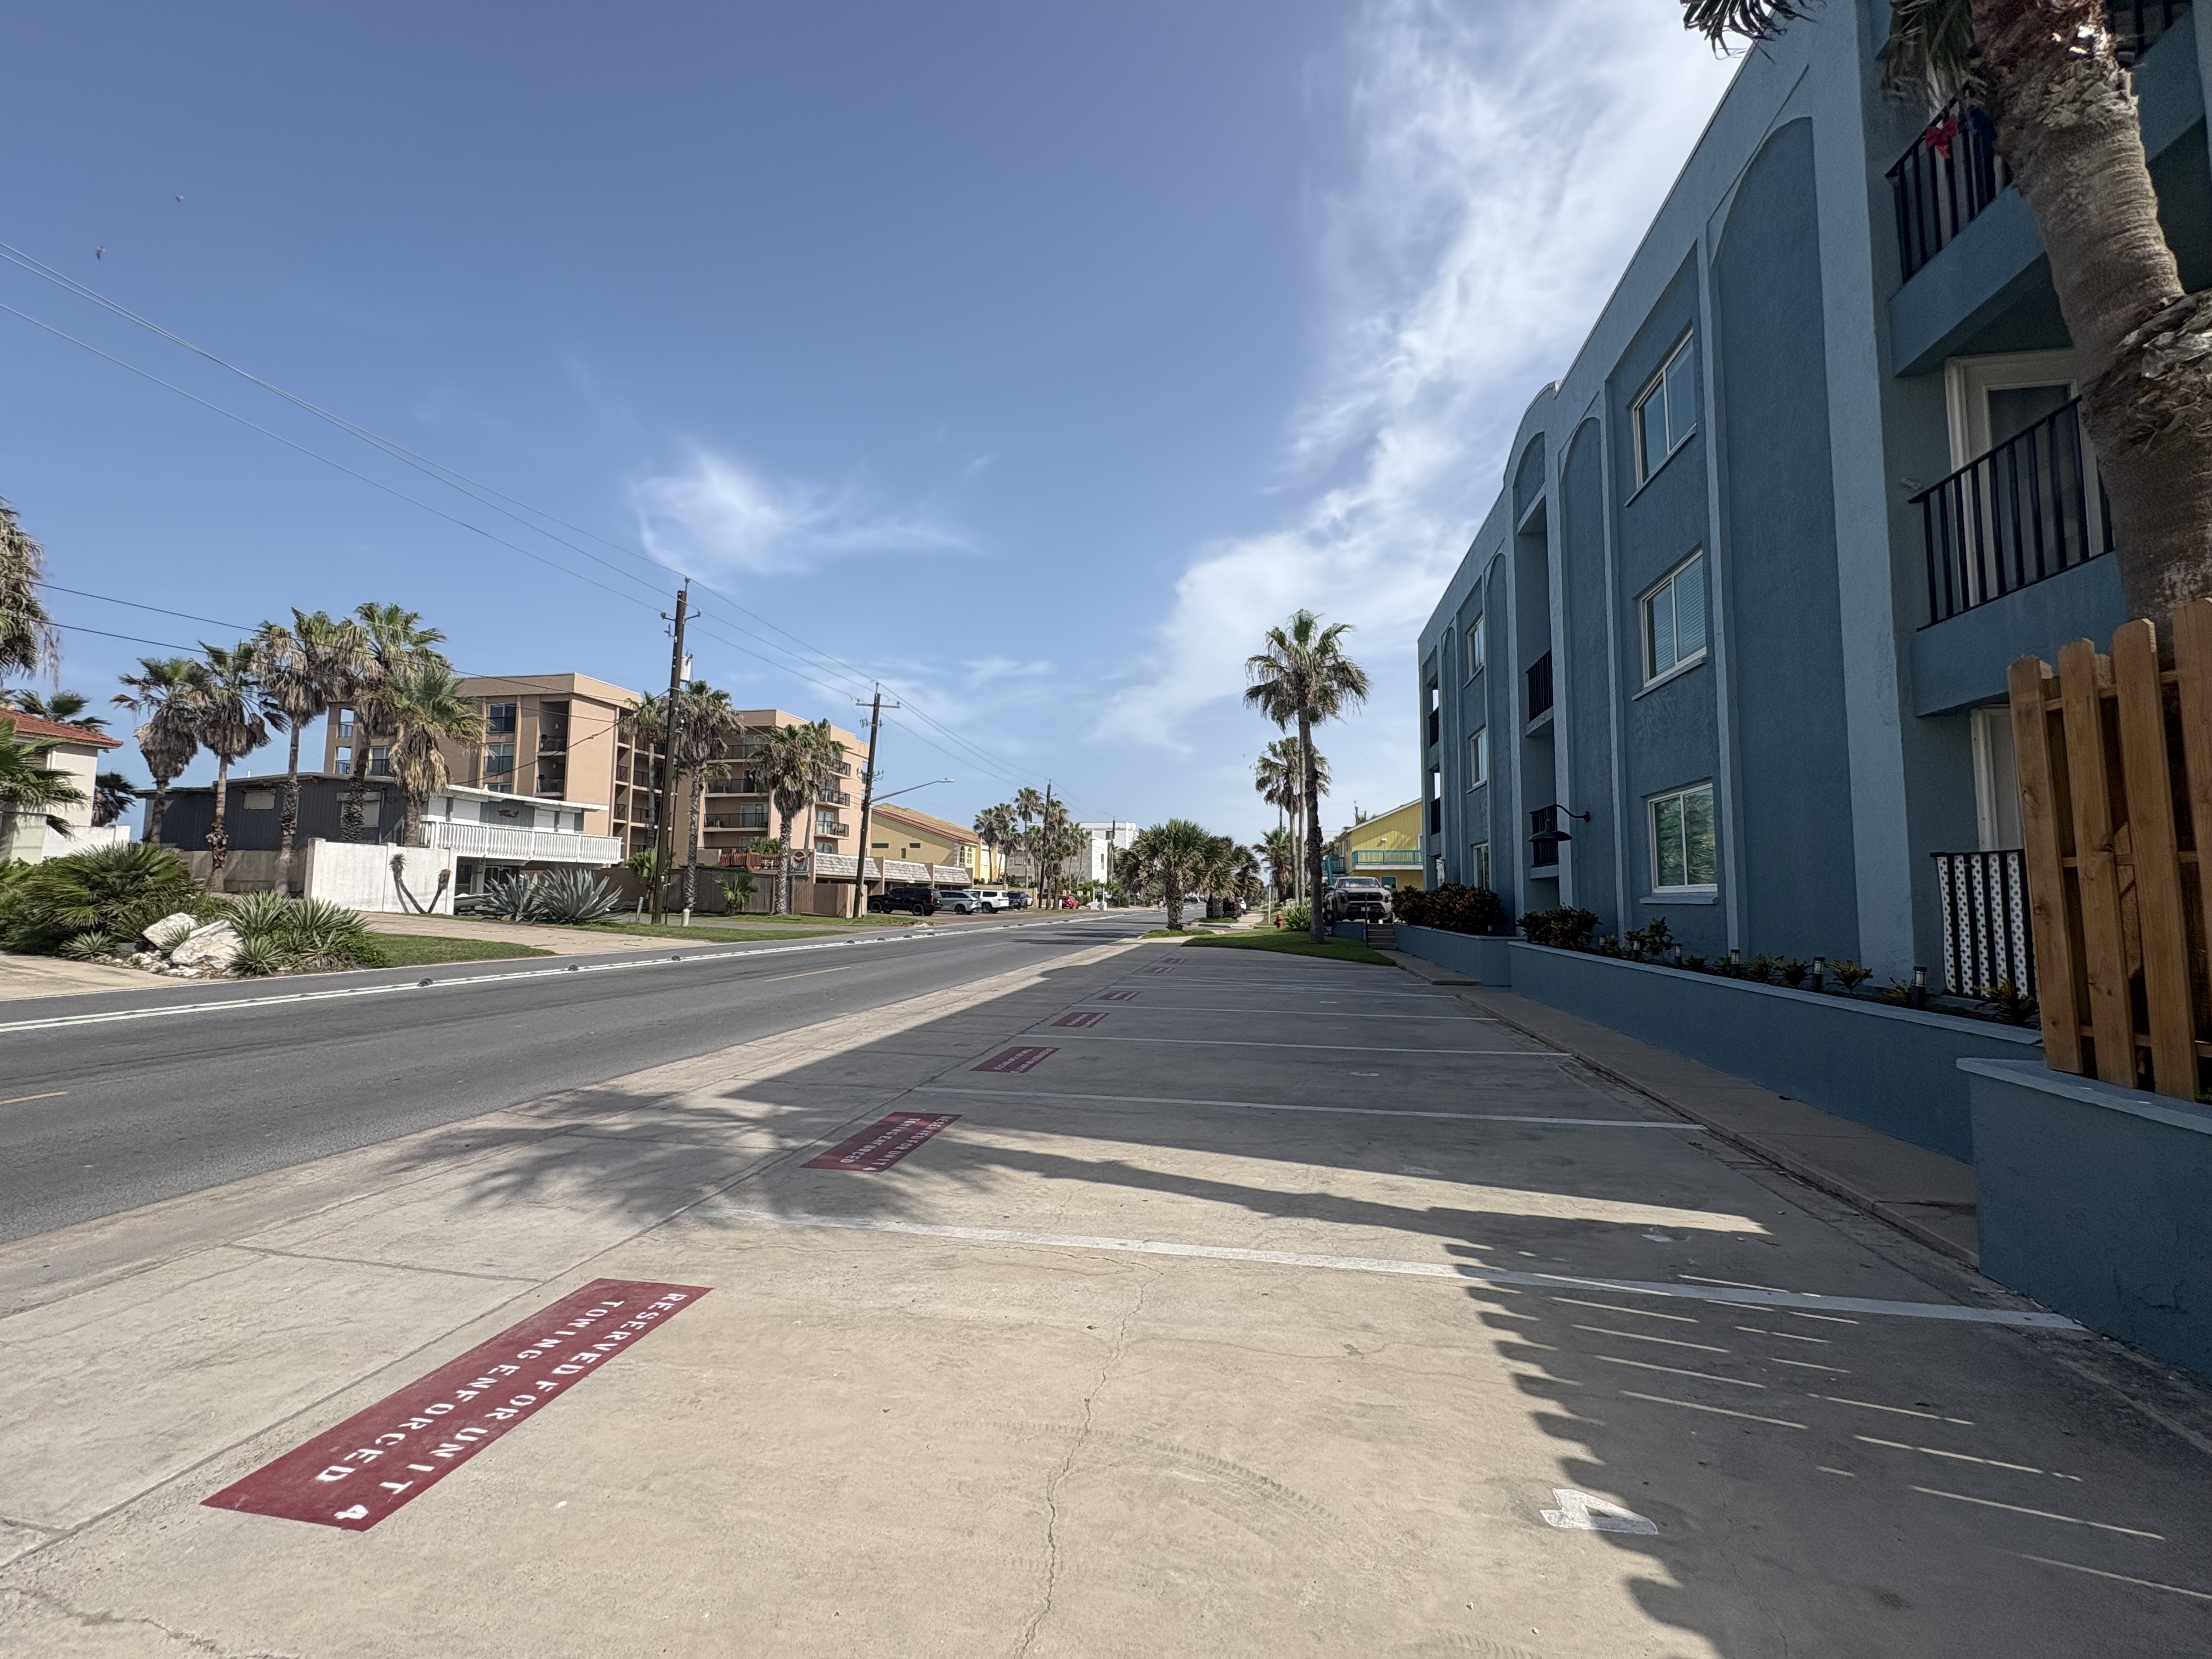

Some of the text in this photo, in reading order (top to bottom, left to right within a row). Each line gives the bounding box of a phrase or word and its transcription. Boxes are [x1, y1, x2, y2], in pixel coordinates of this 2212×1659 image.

[871, 1150, 902, 1166] UNIT
[315, 1300, 625, 1483] TOWING ENFORCED
[333, 1293, 688, 1520] RESERVED FOR UNIT 4
[1539, 1488, 1659, 1536] 4
